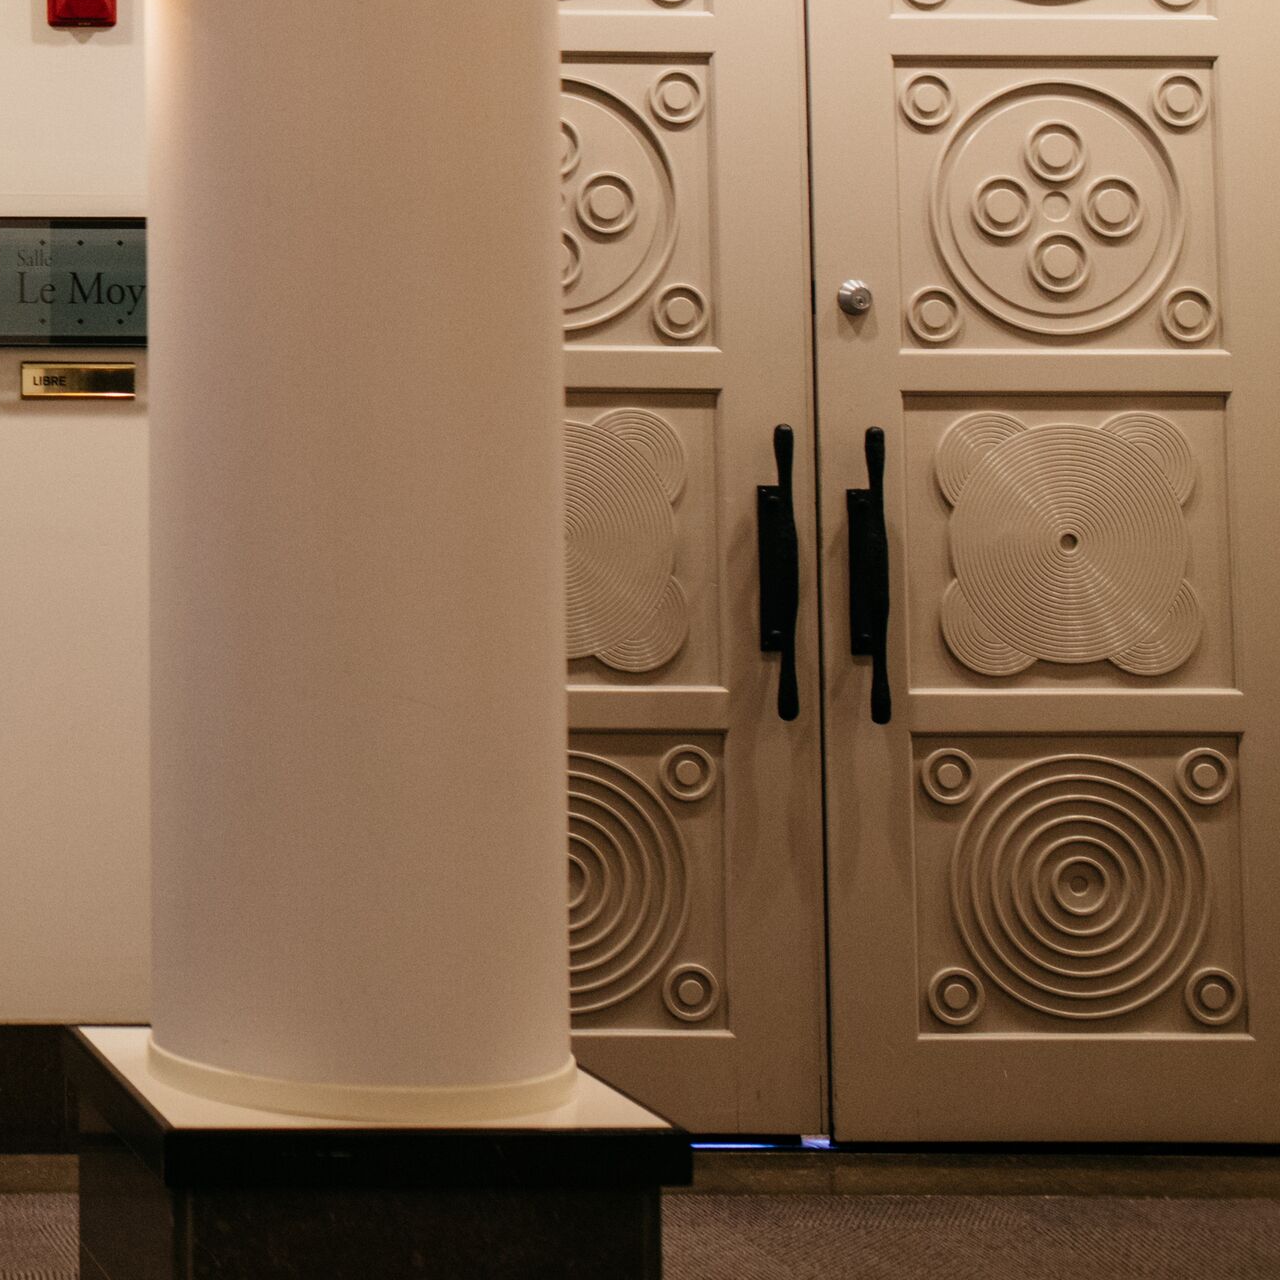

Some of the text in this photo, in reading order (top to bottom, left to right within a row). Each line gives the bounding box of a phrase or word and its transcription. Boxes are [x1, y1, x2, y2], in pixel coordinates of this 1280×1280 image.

[16, 248, 53, 268] Salle
[18, 271, 56, 304] Le
[33, 375, 66, 387] LIBRE
